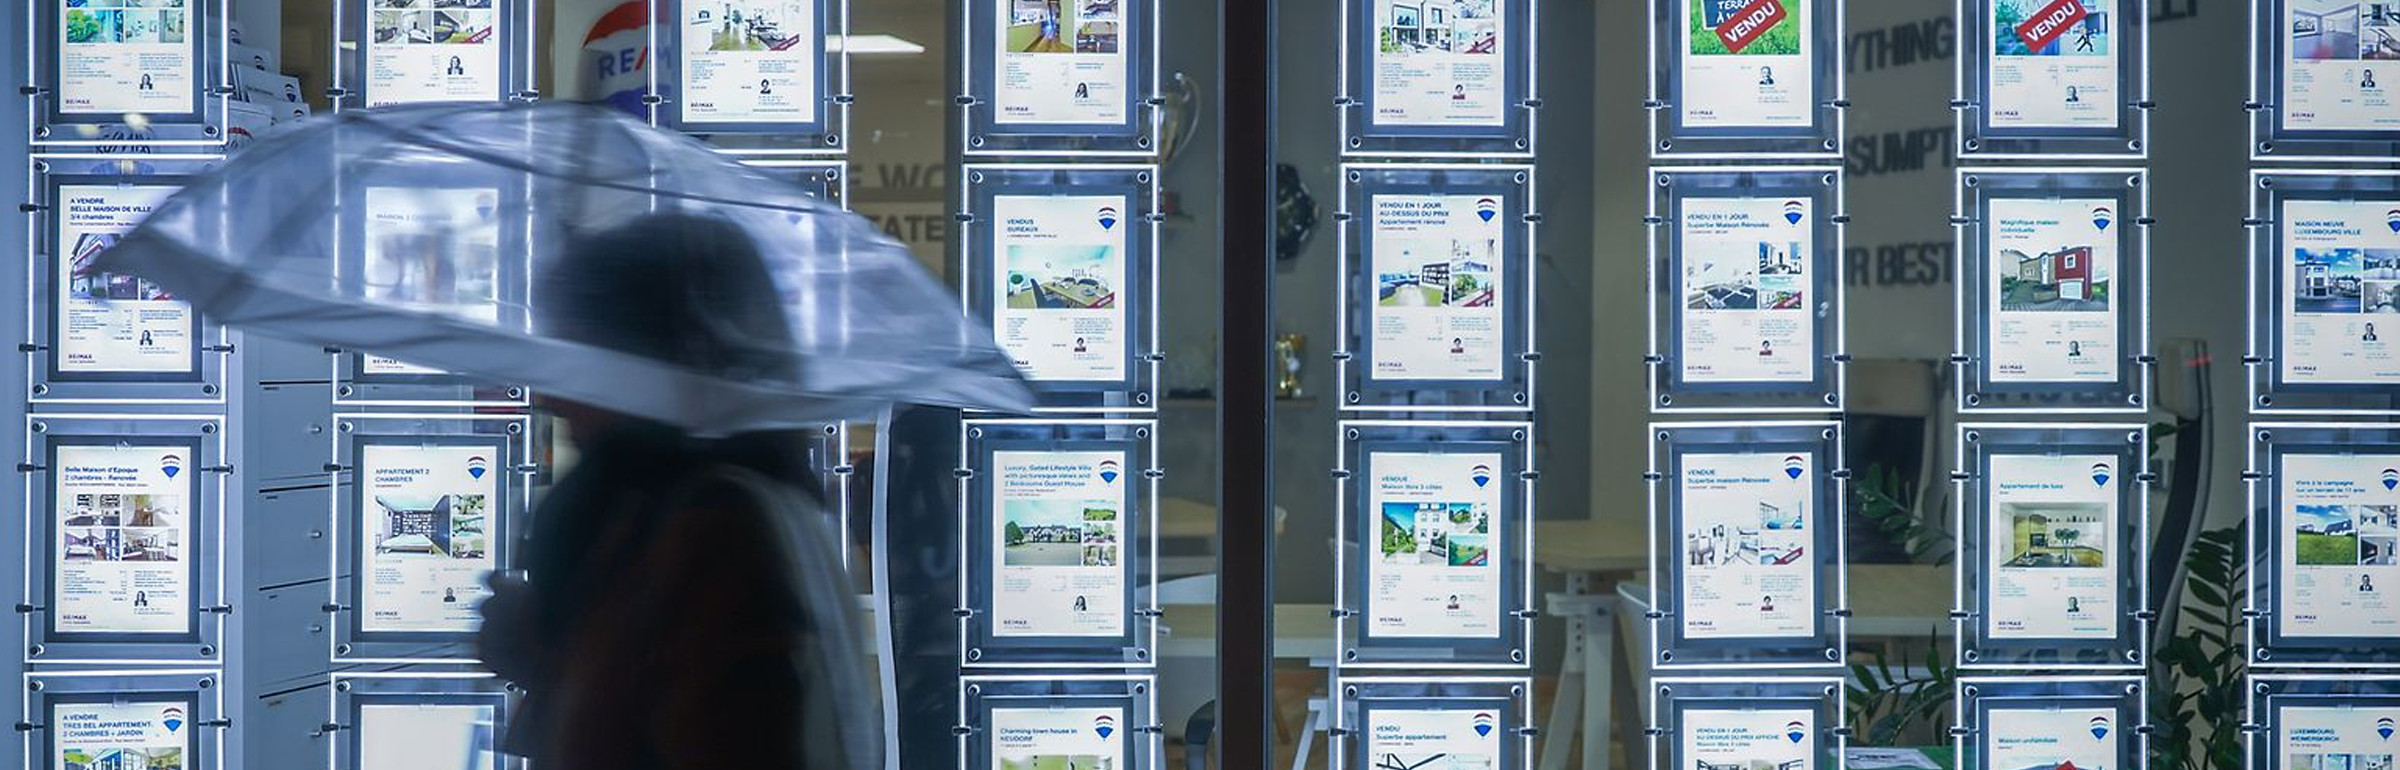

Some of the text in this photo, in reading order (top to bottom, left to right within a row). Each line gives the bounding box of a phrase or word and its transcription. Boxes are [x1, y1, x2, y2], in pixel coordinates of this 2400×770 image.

[1724, 2, 1776, 42] VENDU
[2026, 2, 2076, 42] VENDU
[2000, 219, 2034, 227] Magnifique
[1877, 241, 1954, 286] BEST
